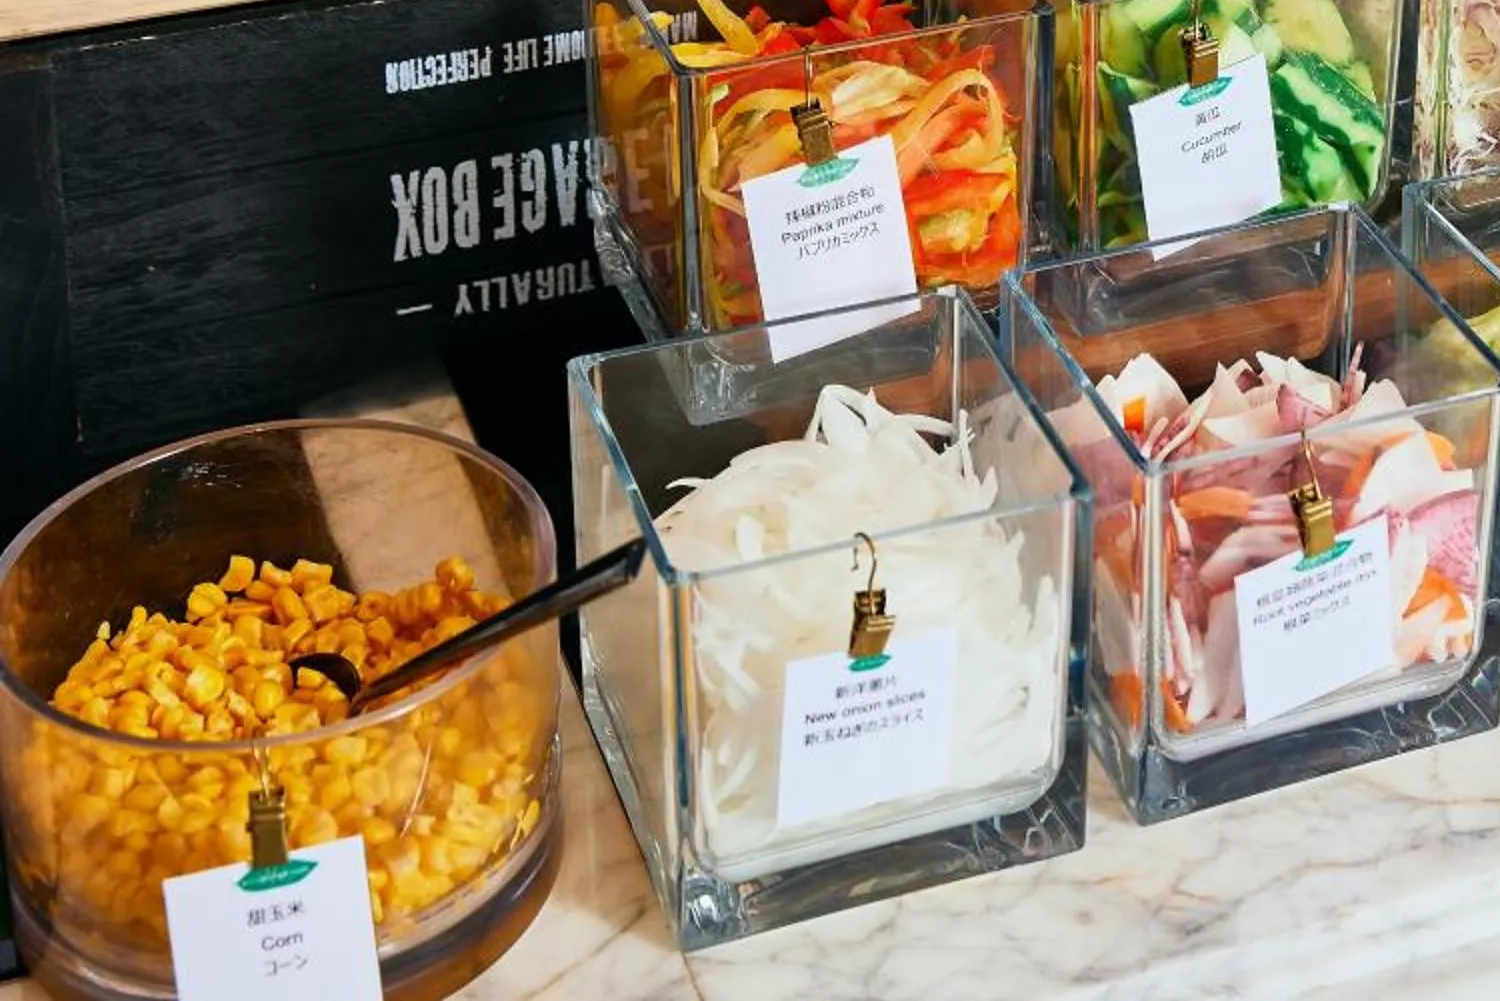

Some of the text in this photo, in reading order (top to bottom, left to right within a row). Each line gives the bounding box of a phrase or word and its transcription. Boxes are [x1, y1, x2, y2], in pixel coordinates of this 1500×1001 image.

[385, 46, 492, 95] PERFECTION
[503, 38, 539, 75] LIFE
[1180, 120, 1243, 154] Cucumber
[390, 159, 481, 263] BOX
[780, 202, 886, 246] Paprika mixture
[804, 689, 927, 725] New onion slices
[261, 932, 304, 952] Corn
[263, 954, 309, 977] コーン
